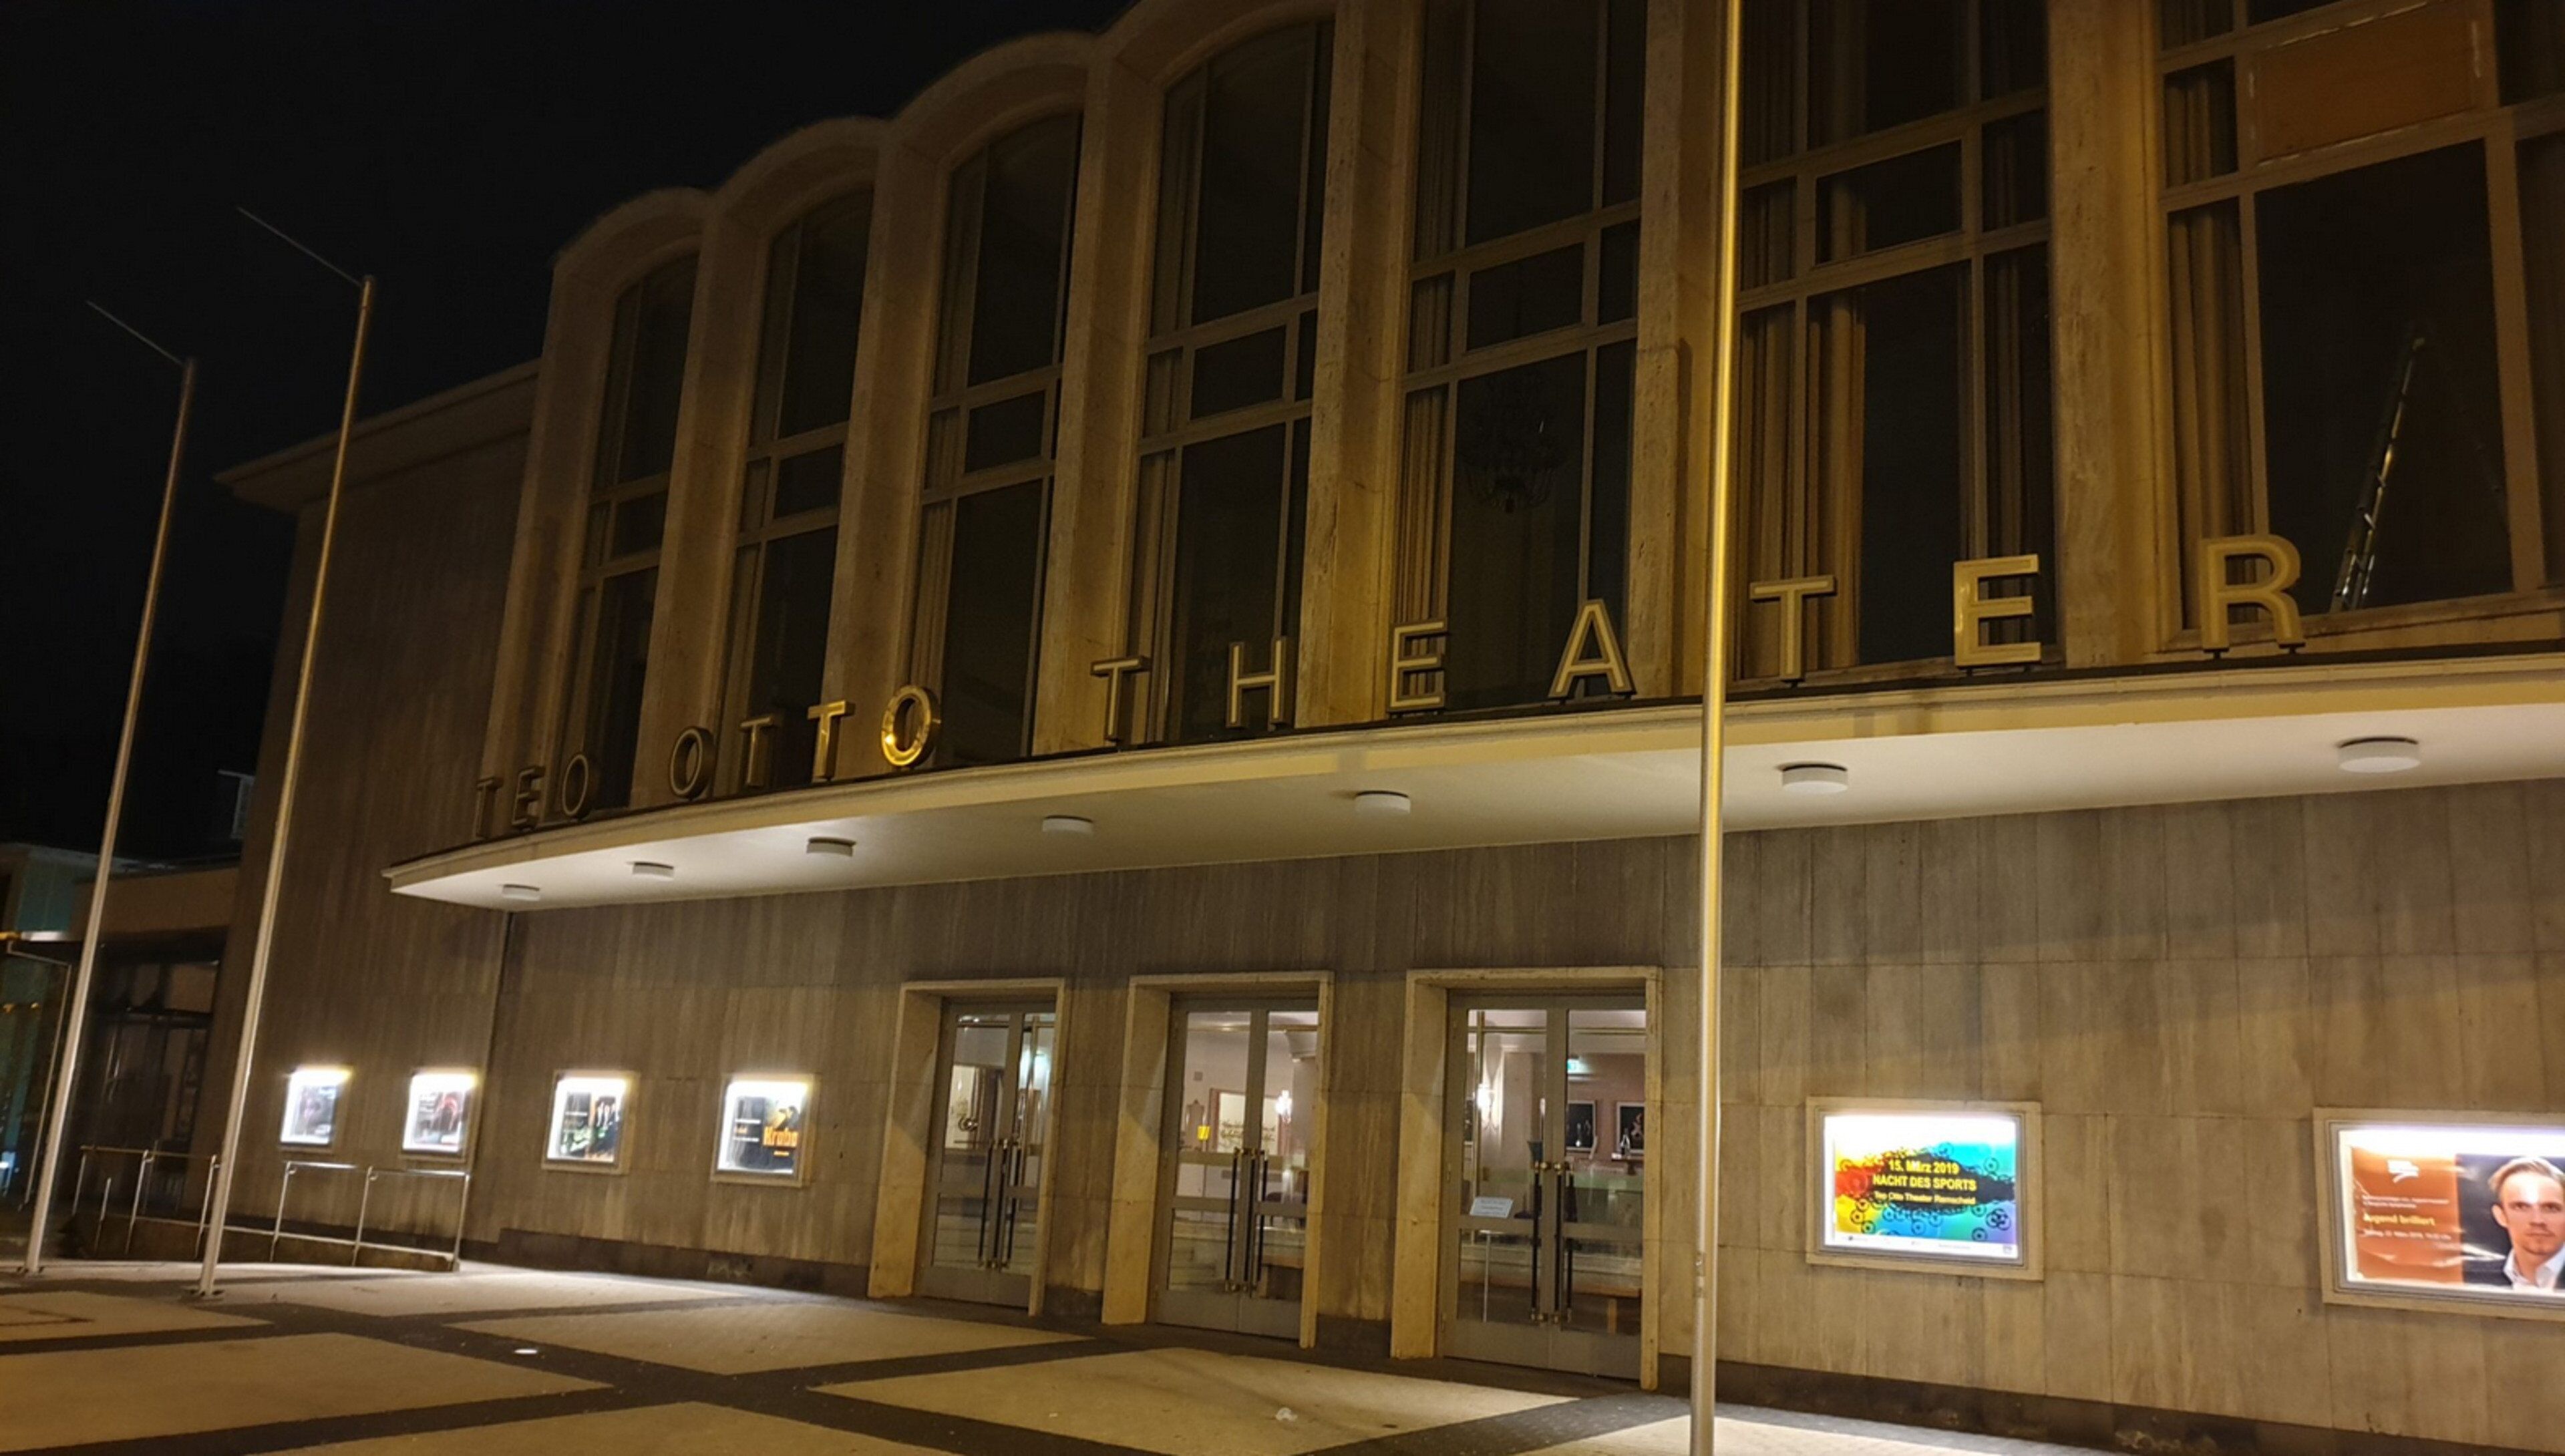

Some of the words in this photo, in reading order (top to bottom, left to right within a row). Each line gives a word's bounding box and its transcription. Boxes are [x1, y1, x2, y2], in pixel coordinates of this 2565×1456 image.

[472, 752, 596, 839] TEO
[669, 685, 937, 798] OTTO
[1090, 534, 2306, 741] THEATER
[1888, 1159, 1904, 1171] 15.
[1906, 1160, 1932, 1173] März
[1933, 1161, 1960, 1175] 2019
[1872, 1174, 1908, 1186] NACHT
[1910, 1176, 1931, 1188] DES
[1933, 1178, 1977, 1192] SPORTS
